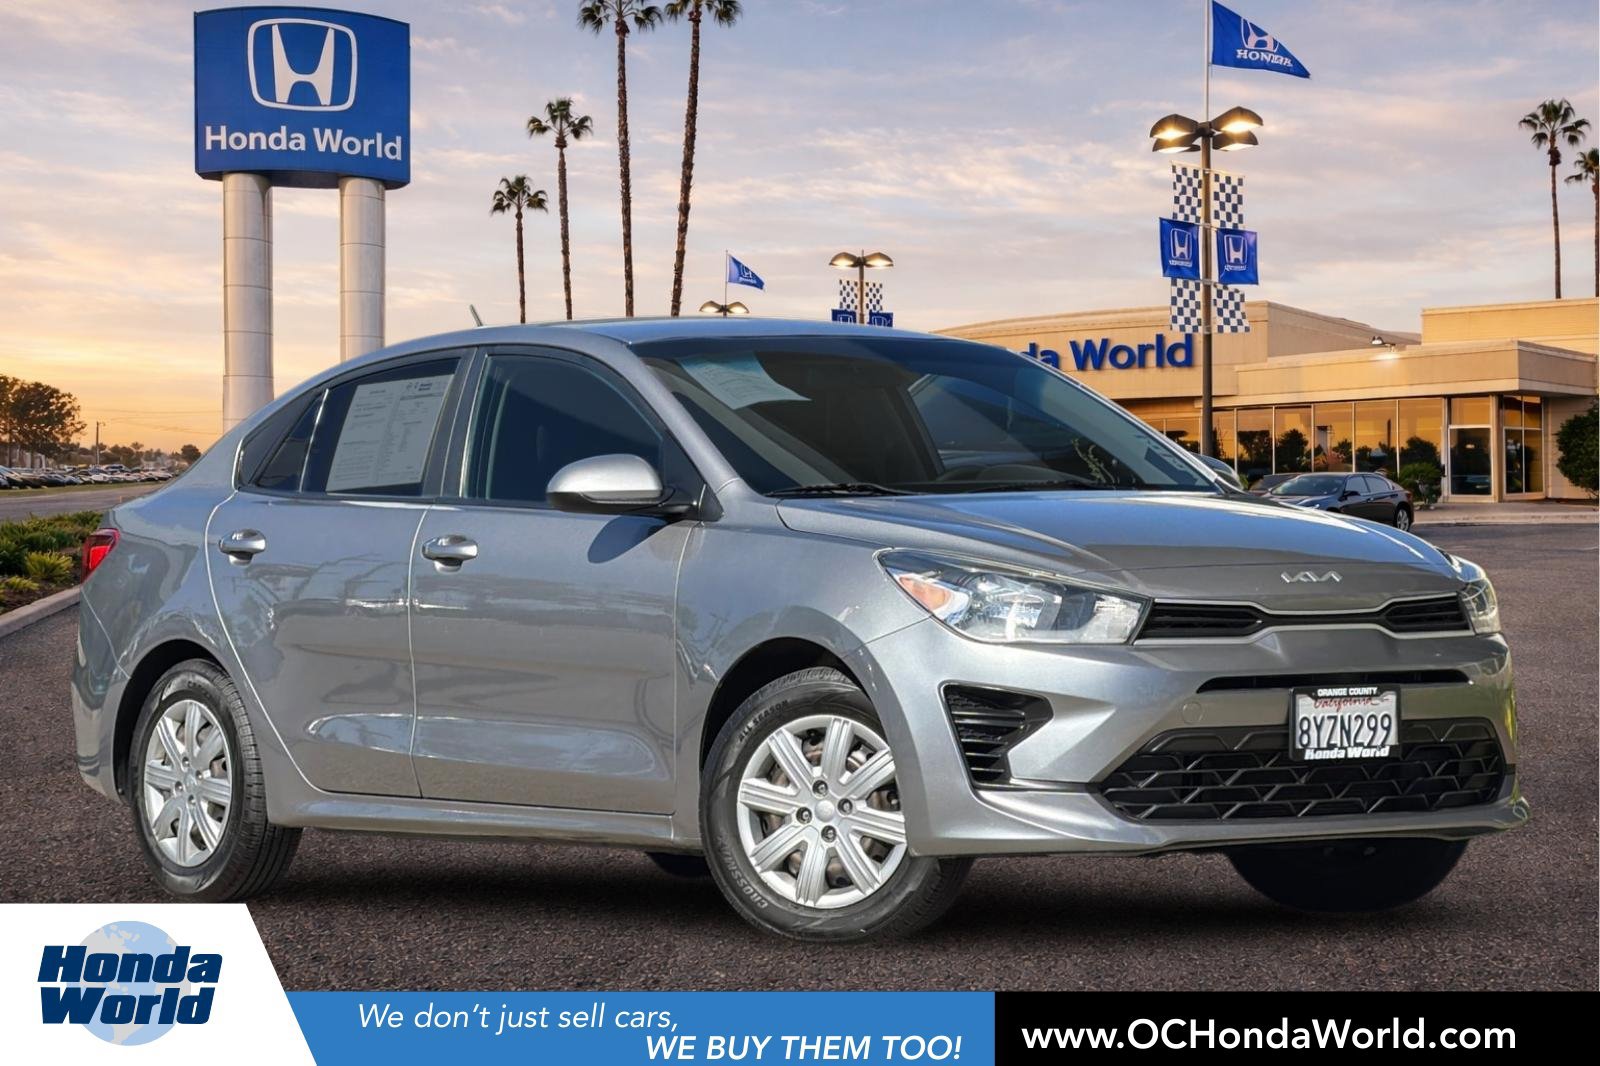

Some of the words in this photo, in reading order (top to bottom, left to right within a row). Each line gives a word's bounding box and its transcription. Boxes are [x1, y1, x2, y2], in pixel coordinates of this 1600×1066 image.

[1236, 48, 1293, 67] HONDA
[205, 125, 306, 151] Honda
[312, 127, 402, 161] World
[1069, 333, 1194, 371] World
[1317, 688, 1347, 697] ORANGE
[1349, 687, 1378, 696] COUNTY
[1299, 714, 1392, 748] 8YZN299
[1304, 748, 1346, 760] Honda
[1347, 746, 1390, 758] World
